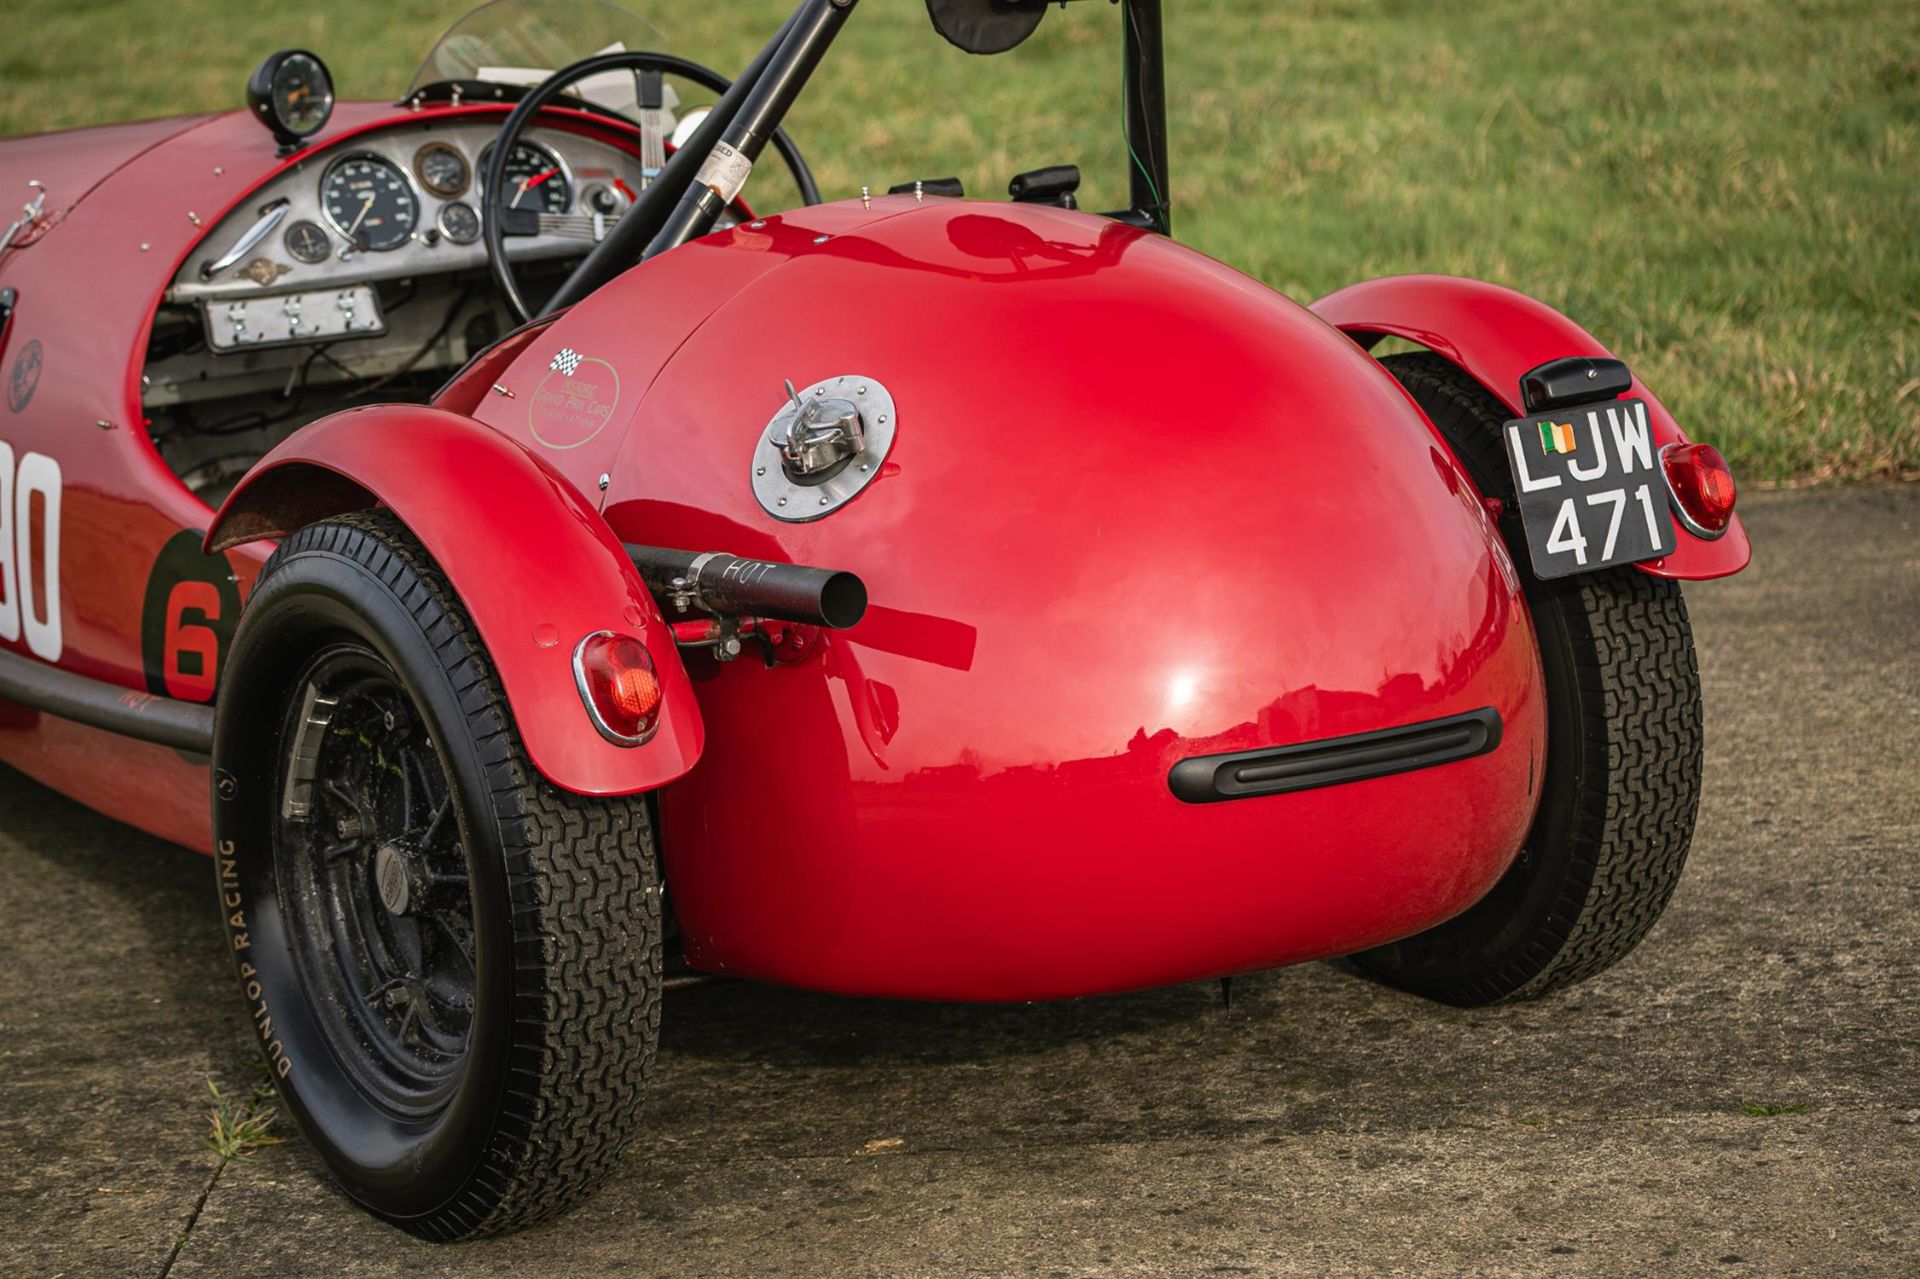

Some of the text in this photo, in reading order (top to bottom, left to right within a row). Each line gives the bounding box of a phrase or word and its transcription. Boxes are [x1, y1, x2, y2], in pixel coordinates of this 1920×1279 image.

[1508, 403, 1653, 492] LJW
[1546, 484, 1662, 565] 471
[722, 560, 776, 584] HOT
[164, 581, 221, 703] 6
[219, 839, 293, 1079] DUNLOP RACING
